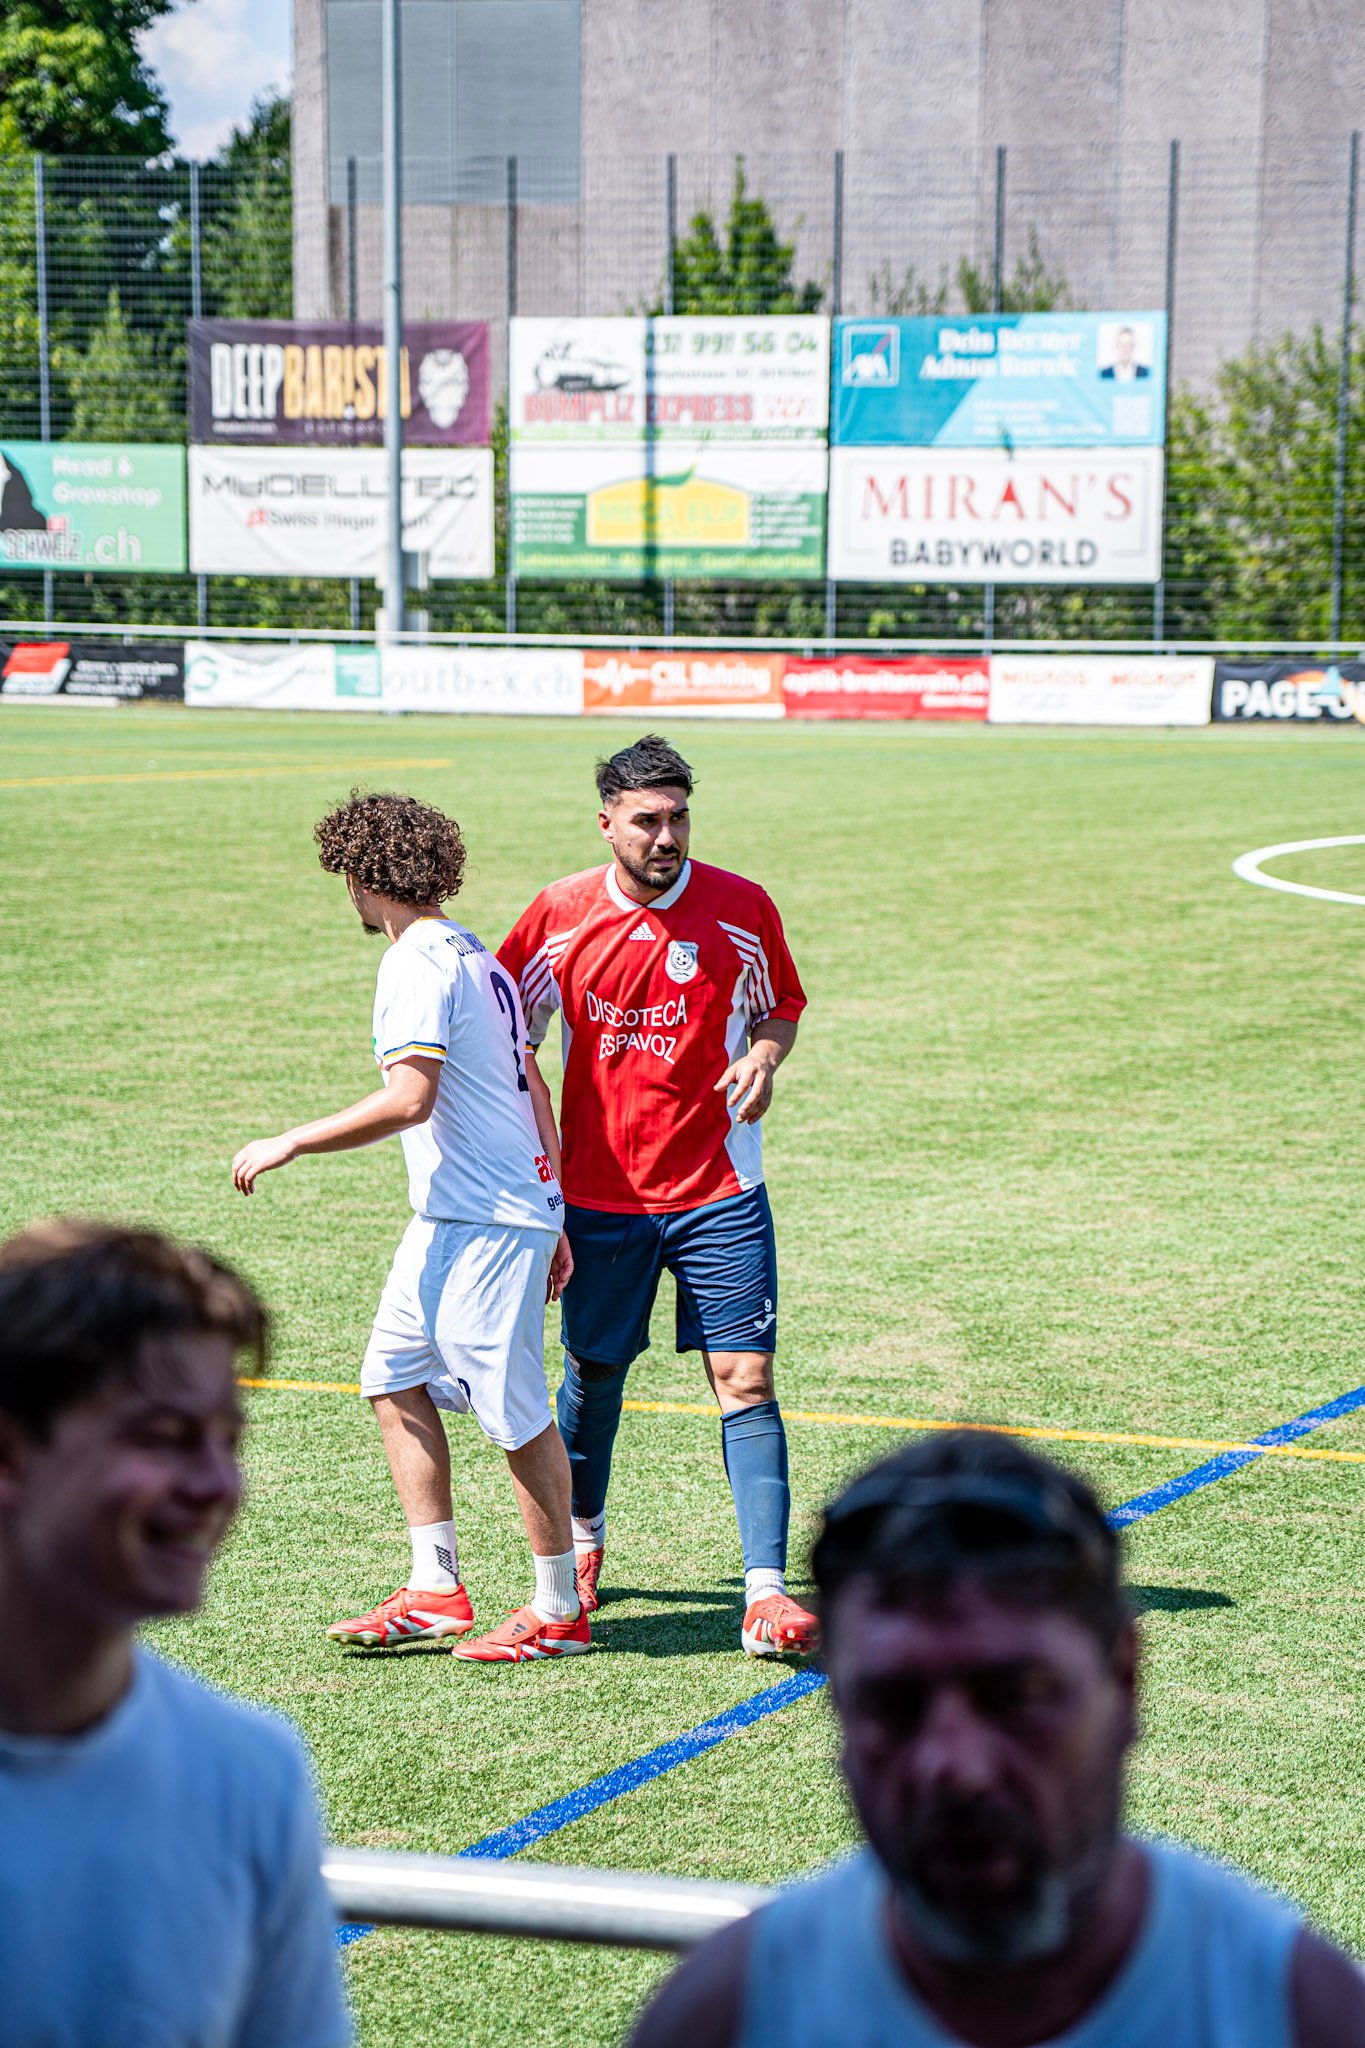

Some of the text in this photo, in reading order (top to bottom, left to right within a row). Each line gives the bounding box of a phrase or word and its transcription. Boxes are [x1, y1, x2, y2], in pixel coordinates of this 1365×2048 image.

[52, 456, 112, 476] Head
[861, 472, 1134, 522] MIRAN'S
[890, 539, 1098, 567] BABYWORLD
[586, 990, 688, 1028] DISCOTECA
[599, 1033, 677, 1065] ESPAVOZ
[764, 1299, 772, 1312] 9
